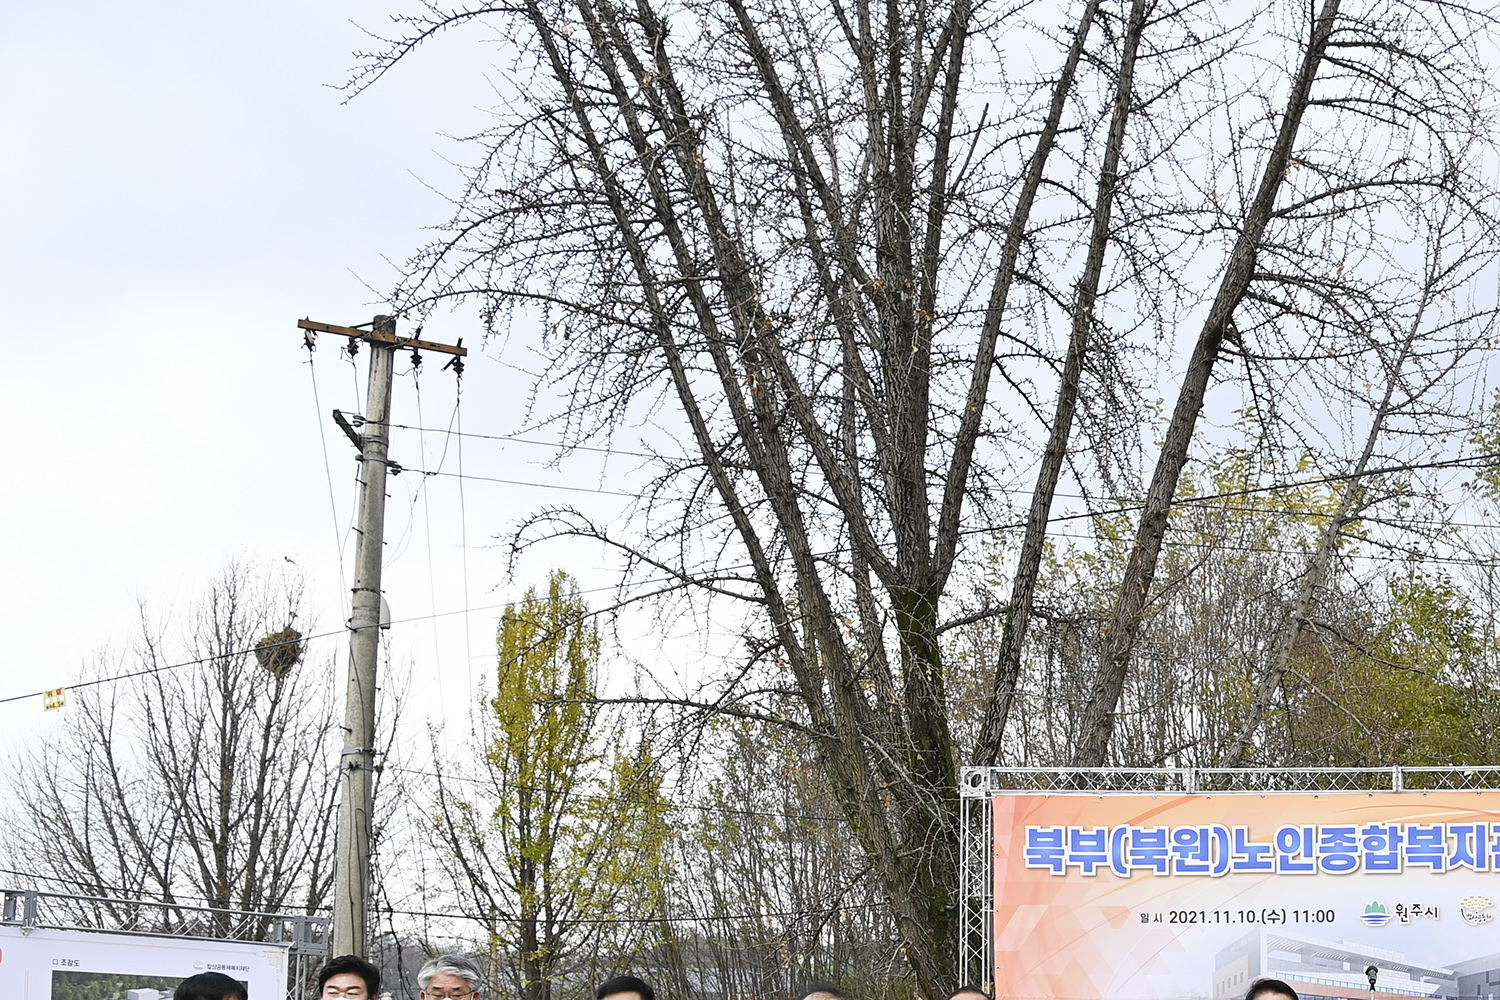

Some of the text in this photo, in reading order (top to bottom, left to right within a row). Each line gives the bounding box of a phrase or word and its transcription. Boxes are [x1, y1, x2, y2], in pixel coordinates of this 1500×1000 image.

[1168, 909, 1287, 925] 2021.11.10.(수)
[1292, 909, 1336, 924] 11:00
[1395, 903, 1438, 923] 원주시
[60, 958, 80, 967] 조감도
